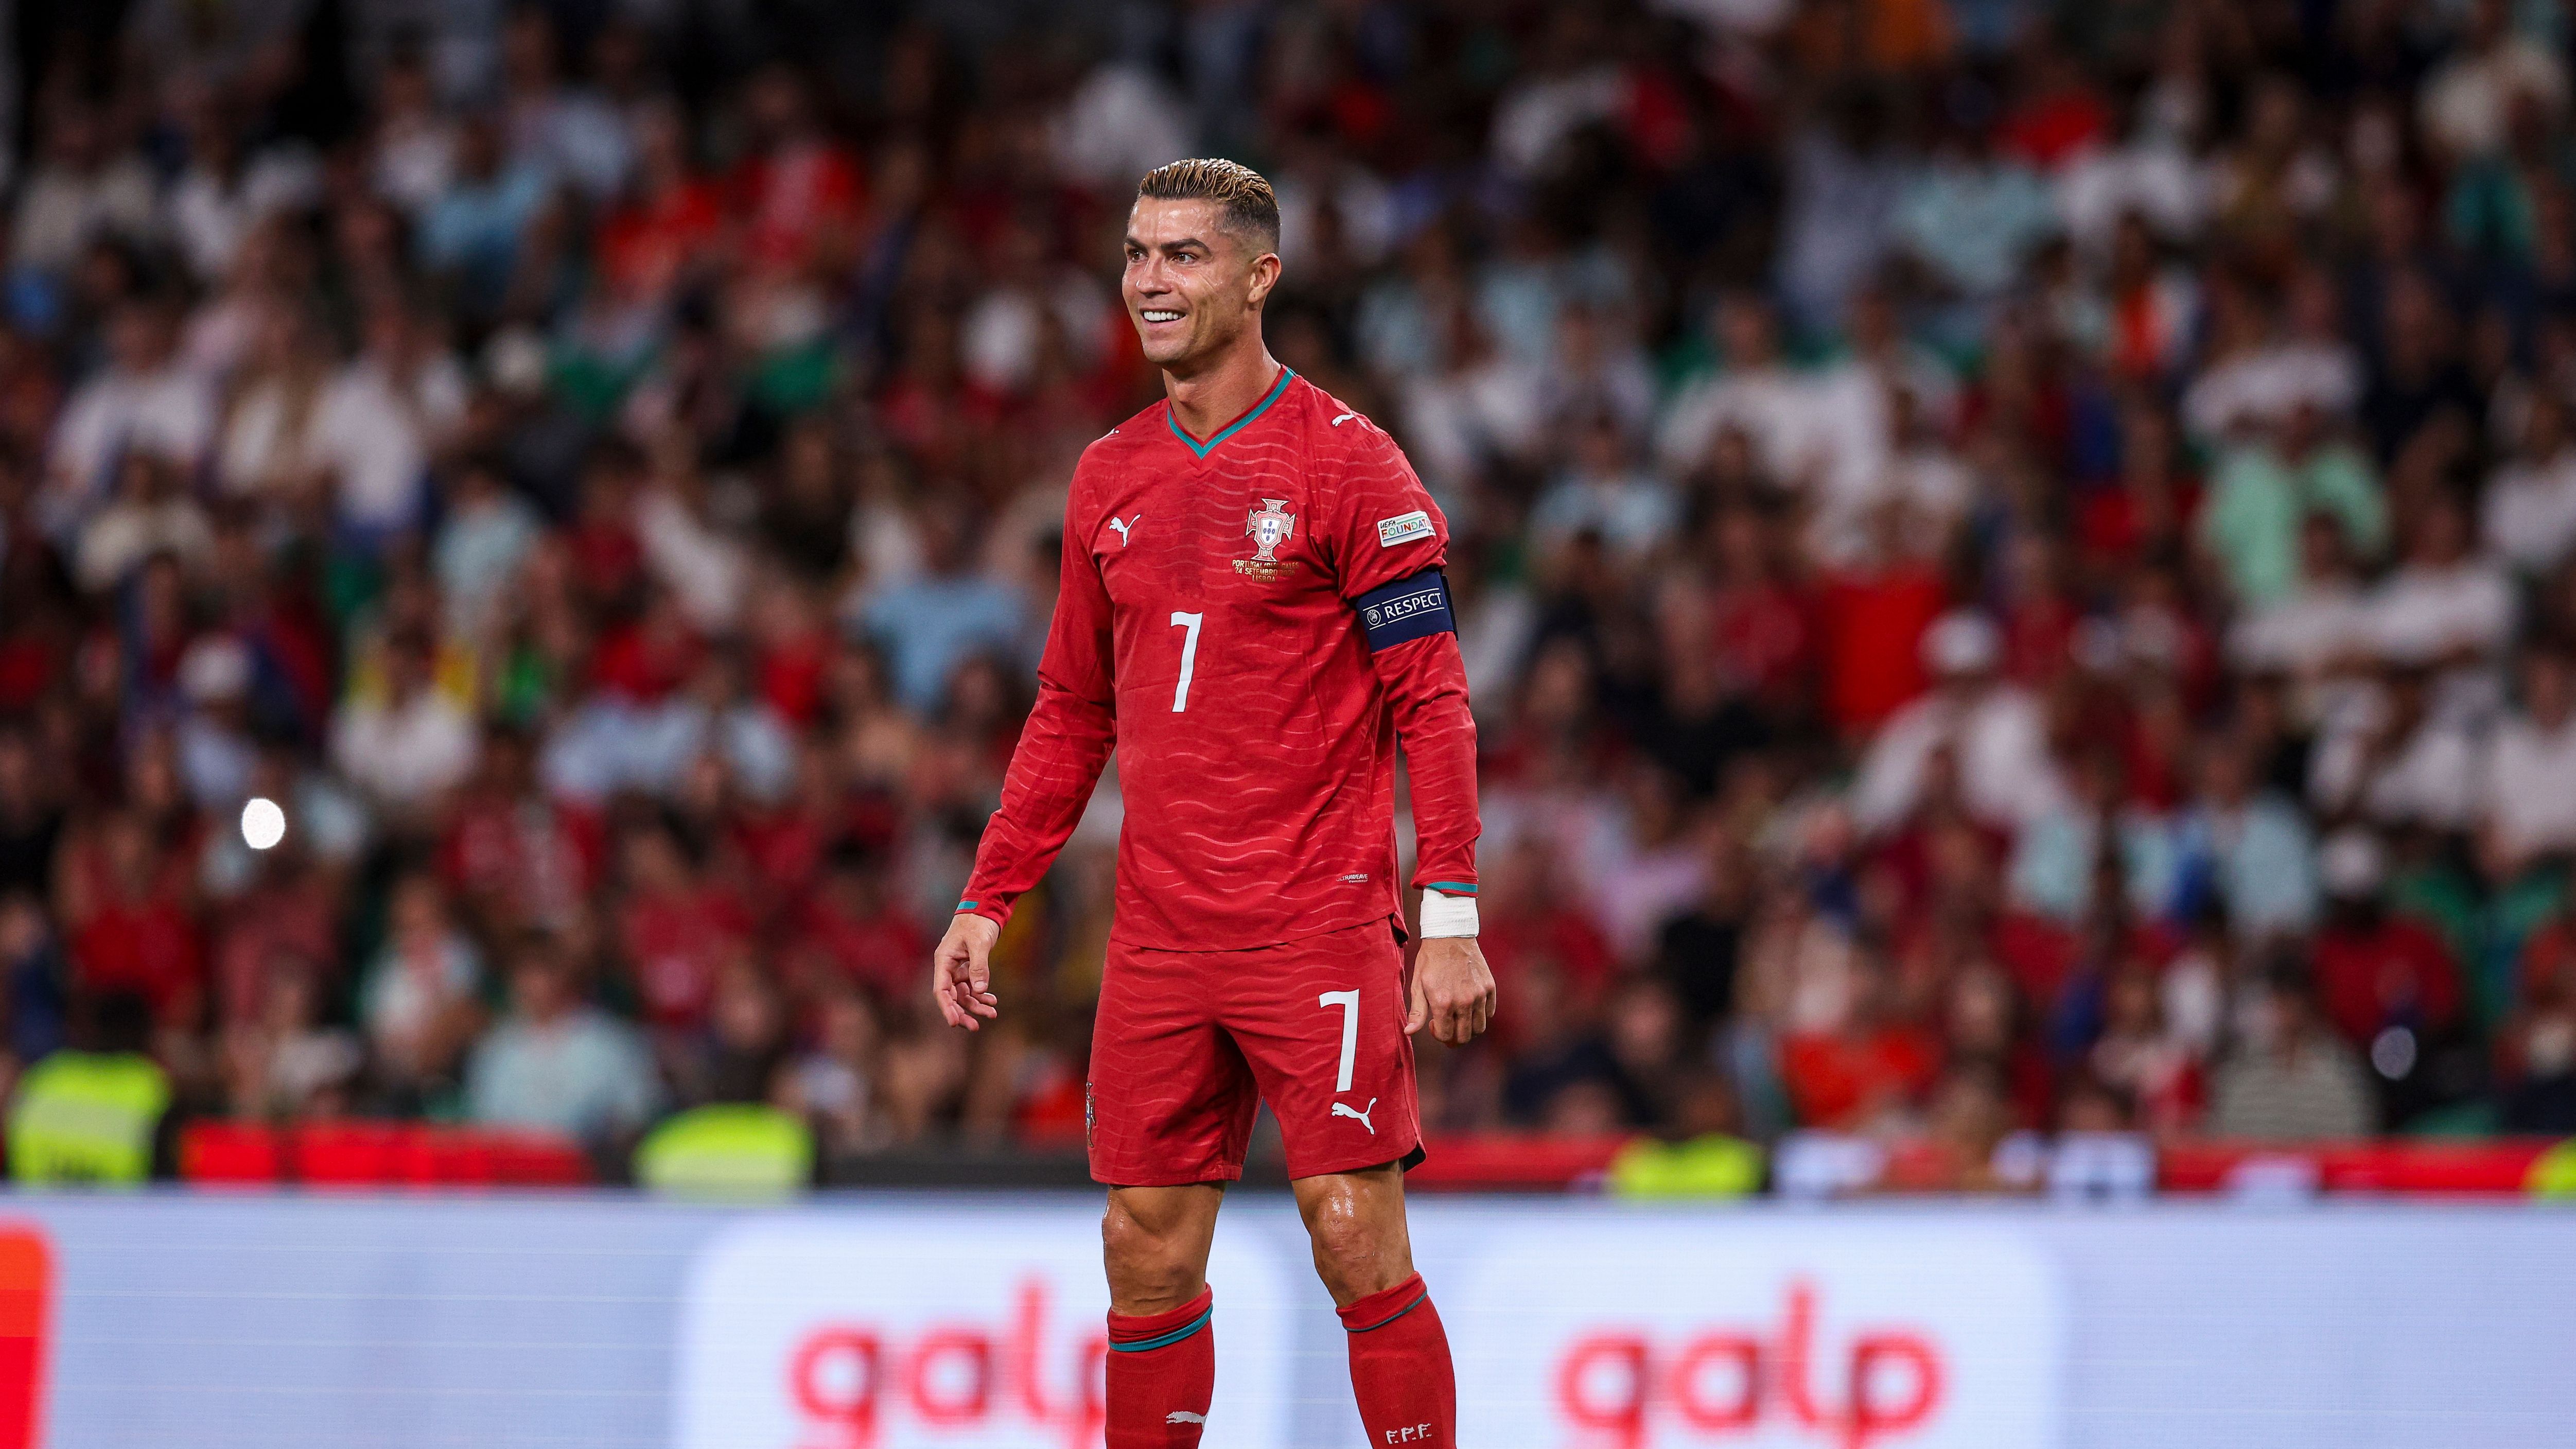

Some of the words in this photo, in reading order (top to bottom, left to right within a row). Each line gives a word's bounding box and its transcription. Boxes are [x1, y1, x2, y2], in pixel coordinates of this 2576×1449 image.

[1380, 520, 1396, 529] UEFA
[1381, 519, 1427, 538] FOUNDAT
[1232, 560, 1263, 569] PORTUGAL
[1245, 568, 1277, 576] SETEMBRO
[1384, 592, 1441, 619] RESPECT
[1170, 611, 1203, 713] 7
[1336, 874, 1369, 882] ULTRAWEAVE
[1318, 988, 1360, 1093] 7
[791, 1286, 1107, 1449] gal
[1558, 1287, 1943, 1449] galp
[1386, 1423, 1432, 1445] F.P.F.
